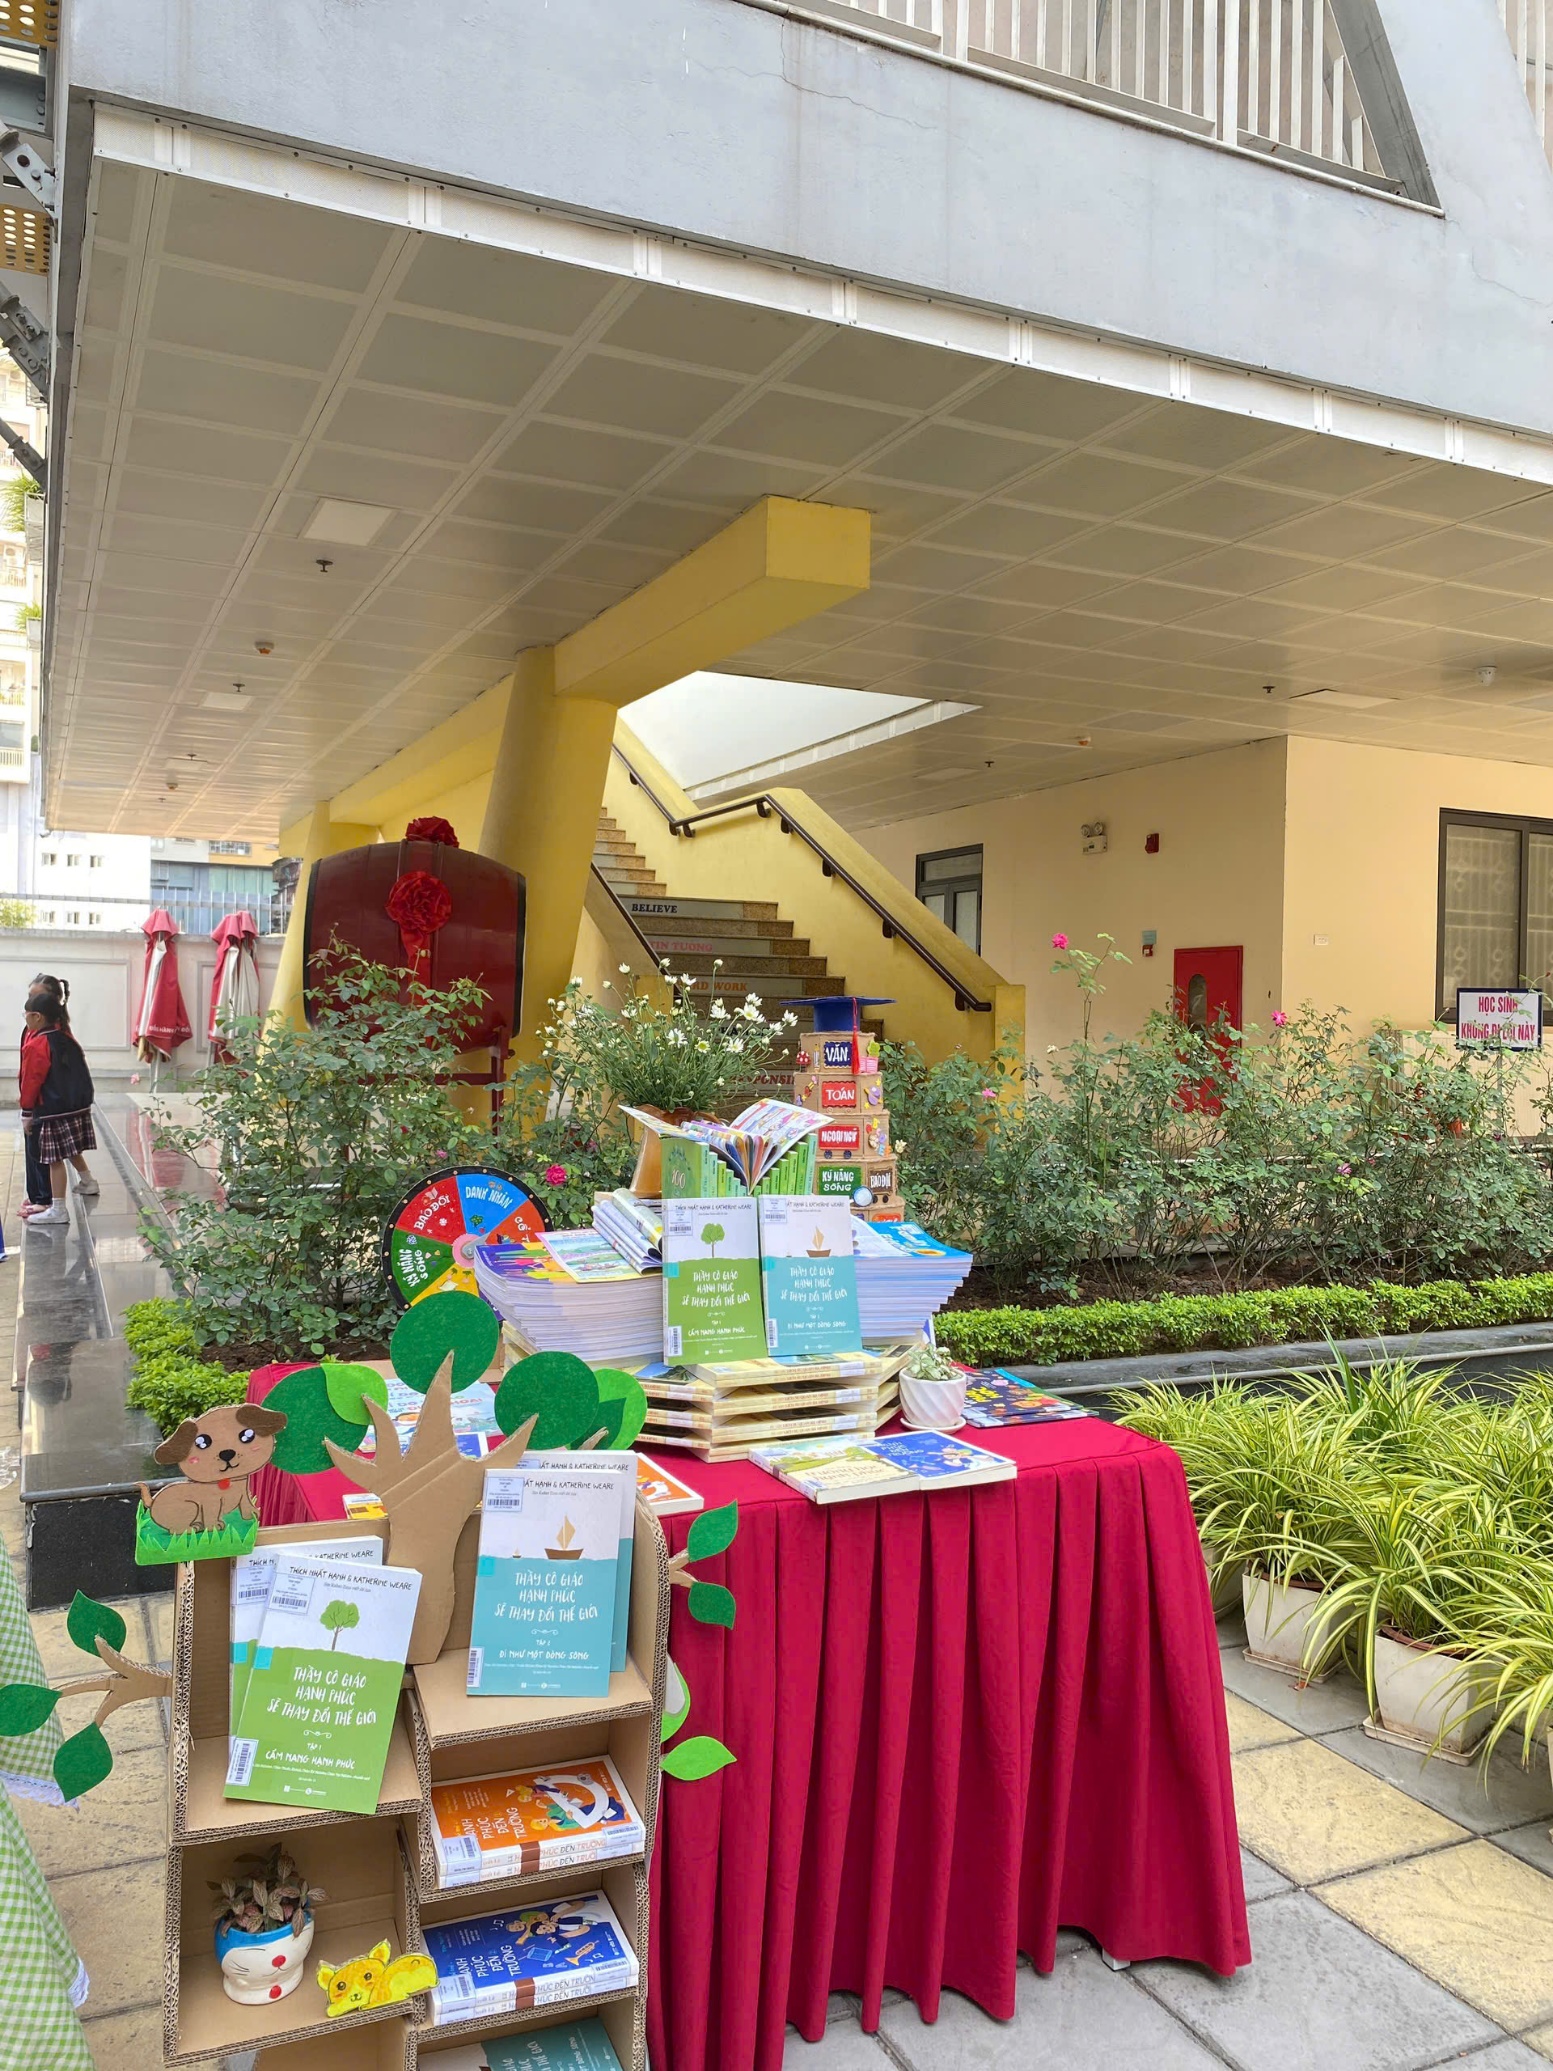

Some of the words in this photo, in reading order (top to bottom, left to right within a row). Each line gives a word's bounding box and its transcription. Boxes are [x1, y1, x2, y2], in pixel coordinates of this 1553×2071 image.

[632, 904, 677, 913] BELIEVE
[714, 981, 747, 991] WORK
[1479, 996, 1495, 1016] HỌC
[1498, 996, 1518, 1013] SINH
[1518, 1020, 1535, 1040] NÀY
[825, 1087, 855, 1101] TOÁN
[833, 1168, 854, 1182] NĂNG
[465, 1186, 488, 1200] DANH
[823, 1182, 851, 1191] SỐNG
[413, 1209, 433, 1230] BÁO
[397, 1248, 414, 1273] NĂNG
[414, 1249, 428, 1280] SỐNG
[574, 1462, 606, 1470] KATHERINE
[607, 1463, 629, 1471] WEARE
[558, 1480, 591, 1489] KATHERINE
[592, 1482, 614, 1490] WEARE
[351, 1550, 374, 1558] WEARE
[289, 1566, 308, 1575] THÍCH
[308, 1567, 328, 1579] NHẤT
[353, 1575, 388, 1588] KATHERINE
[389, 1581, 413, 1590] WEARE
[515, 1569, 542, 1586] THẦY
[545, 1571, 557, 1586] CÔ
[560, 1571, 584, 1586] GIÁO
[519, 1588, 547, 1604] HẠNH
[551, 1588, 576, 1603] PHÚC
[494, 1603, 506, 1617] SẼ
[509, 1605, 535, 1622] THAY
[538, 1605, 555, 1622] ĐỔI
[559, 1604, 576, 1622] THẾ
[579, 1603, 598, 1621] GIỚI
[509, 1649, 525, 1658] NHƯ
[527, 1650, 543, 1660] MỘT
[545, 1651, 566, 1660] DÒNG
[569, 1651, 589, 1660] SÔNG
[293, 1664, 322, 1684] THẦY
[325, 1670, 339, 1685] CÔ
[341, 1672, 367, 1689] GIÁO
[295, 1686, 325, 1703] HẠNH
[328, 1687, 356, 1706] PHÚC
[267, 1697, 280, 1713] SẼ
[281, 1702, 311, 1721] THAY
[312, 1705, 331, 1724] ĐỔI
[334, 1706, 353, 1726] THẾ
[356, 1708, 377, 1725] GIỚI
[285, 1752, 309, 1764] NANG
[311, 1756, 333, 1767] HẠNH
[335, 1757, 356, 1769] PHÚC
[461, 1818, 478, 1836] ẠNH
[476, 1817, 495, 1839] PHÚC
[492, 1817, 509, 1834] ĐẾN
[506, 1807, 528, 1840] TRƯỜNG
[456, 1957, 471, 1976] ẠNH
[471, 1955, 490, 1978] PHÚC
[486, 1954, 505, 1973] ĐẾN
[500, 1944, 523, 1976] TRƯỜNG
